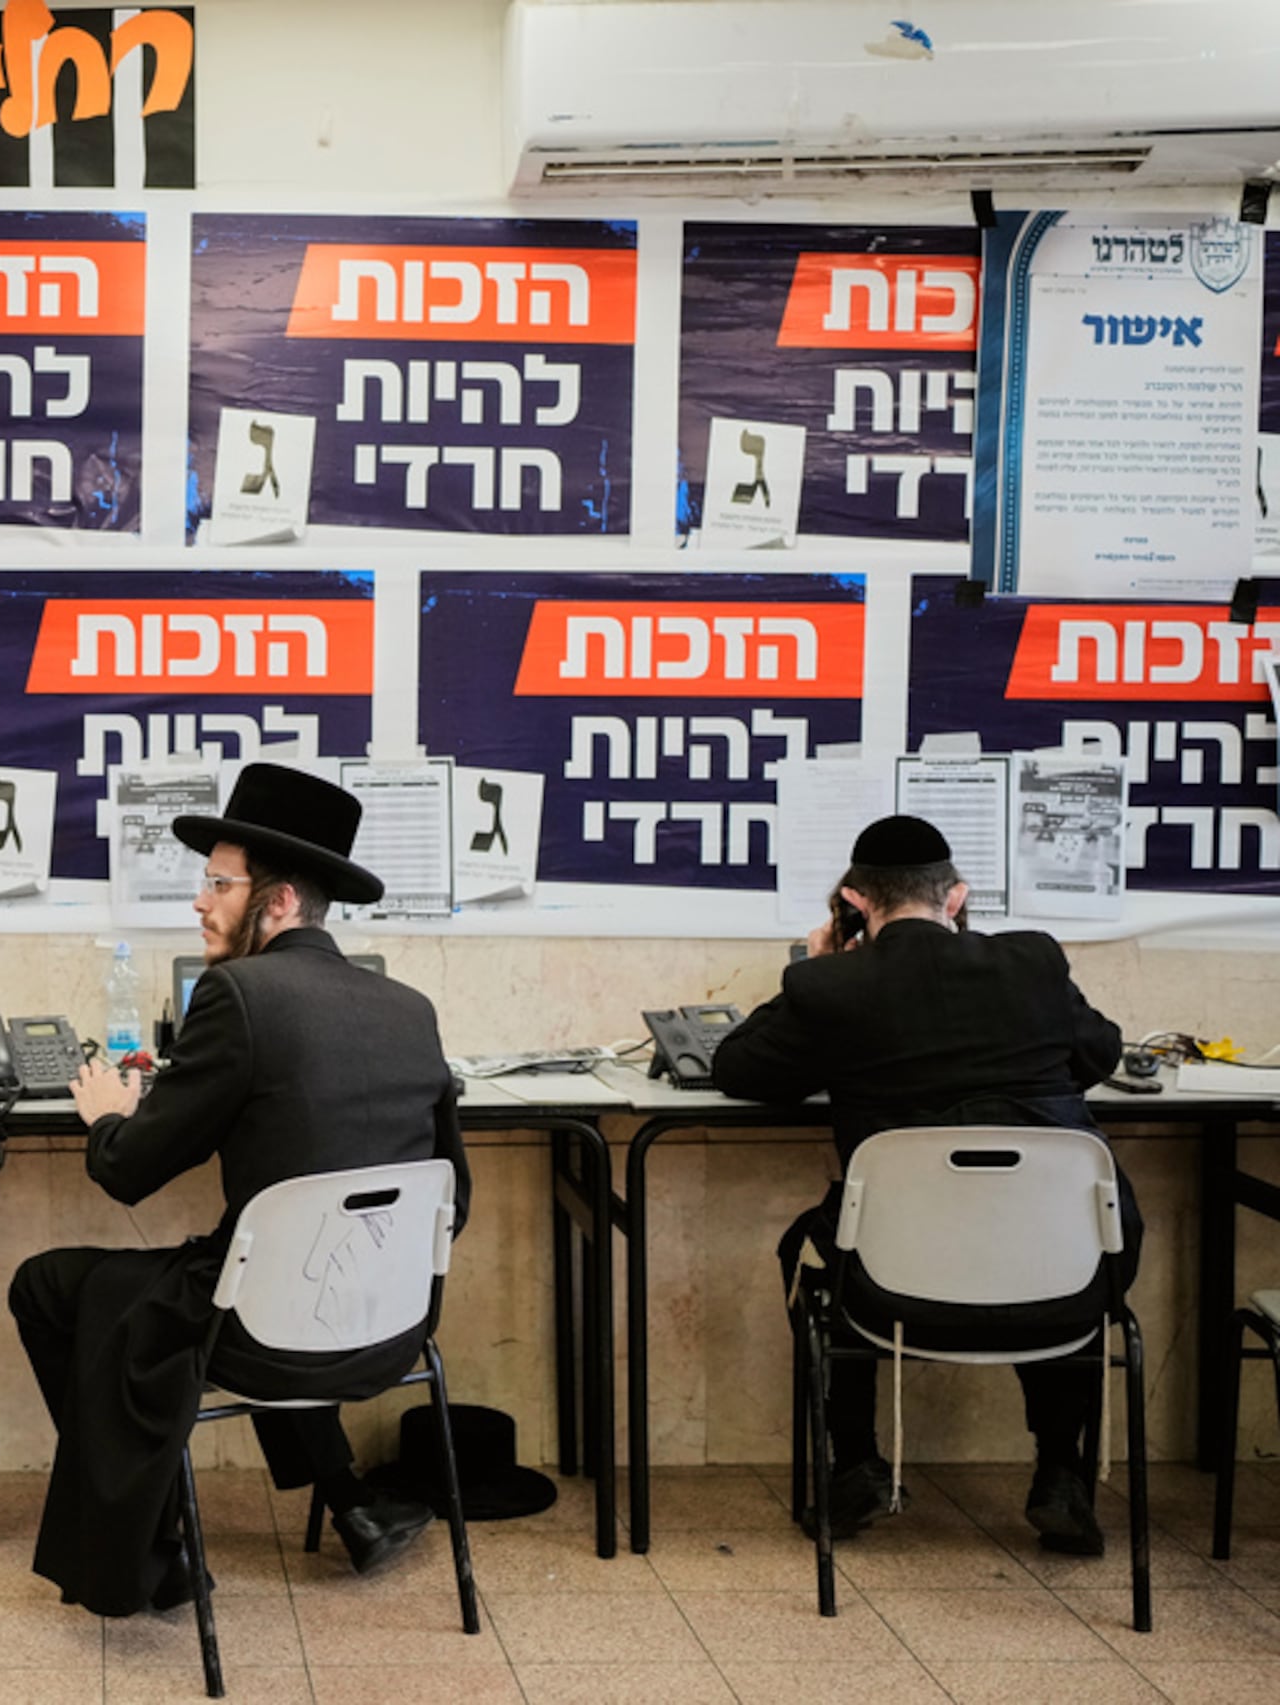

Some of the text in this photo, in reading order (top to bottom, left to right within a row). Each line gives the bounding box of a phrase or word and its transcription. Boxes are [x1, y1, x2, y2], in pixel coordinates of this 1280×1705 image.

[331, 259, 589, 325] הזכות
[823, 269, 975, 332] כות
[1082, 315, 1202, 347] אישור
[337, 355, 580, 425] להיות
[827, 369, 976, 433] יות
[242, 423, 278, 497] ג
[355, 445, 561, 510] חרדי
[732, 432, 770, 507] ג
[847, 455, 972, 519] רדי
[71, 615, 326, 676] הזכות
[560, 617, 817, 679] הזכות
[565, 709, 808, 781] להיות
[469, 776, 508, 855] ג
[583, 802, 778, 866] חרדי
[1125, 806, 1280, 870] חרד
